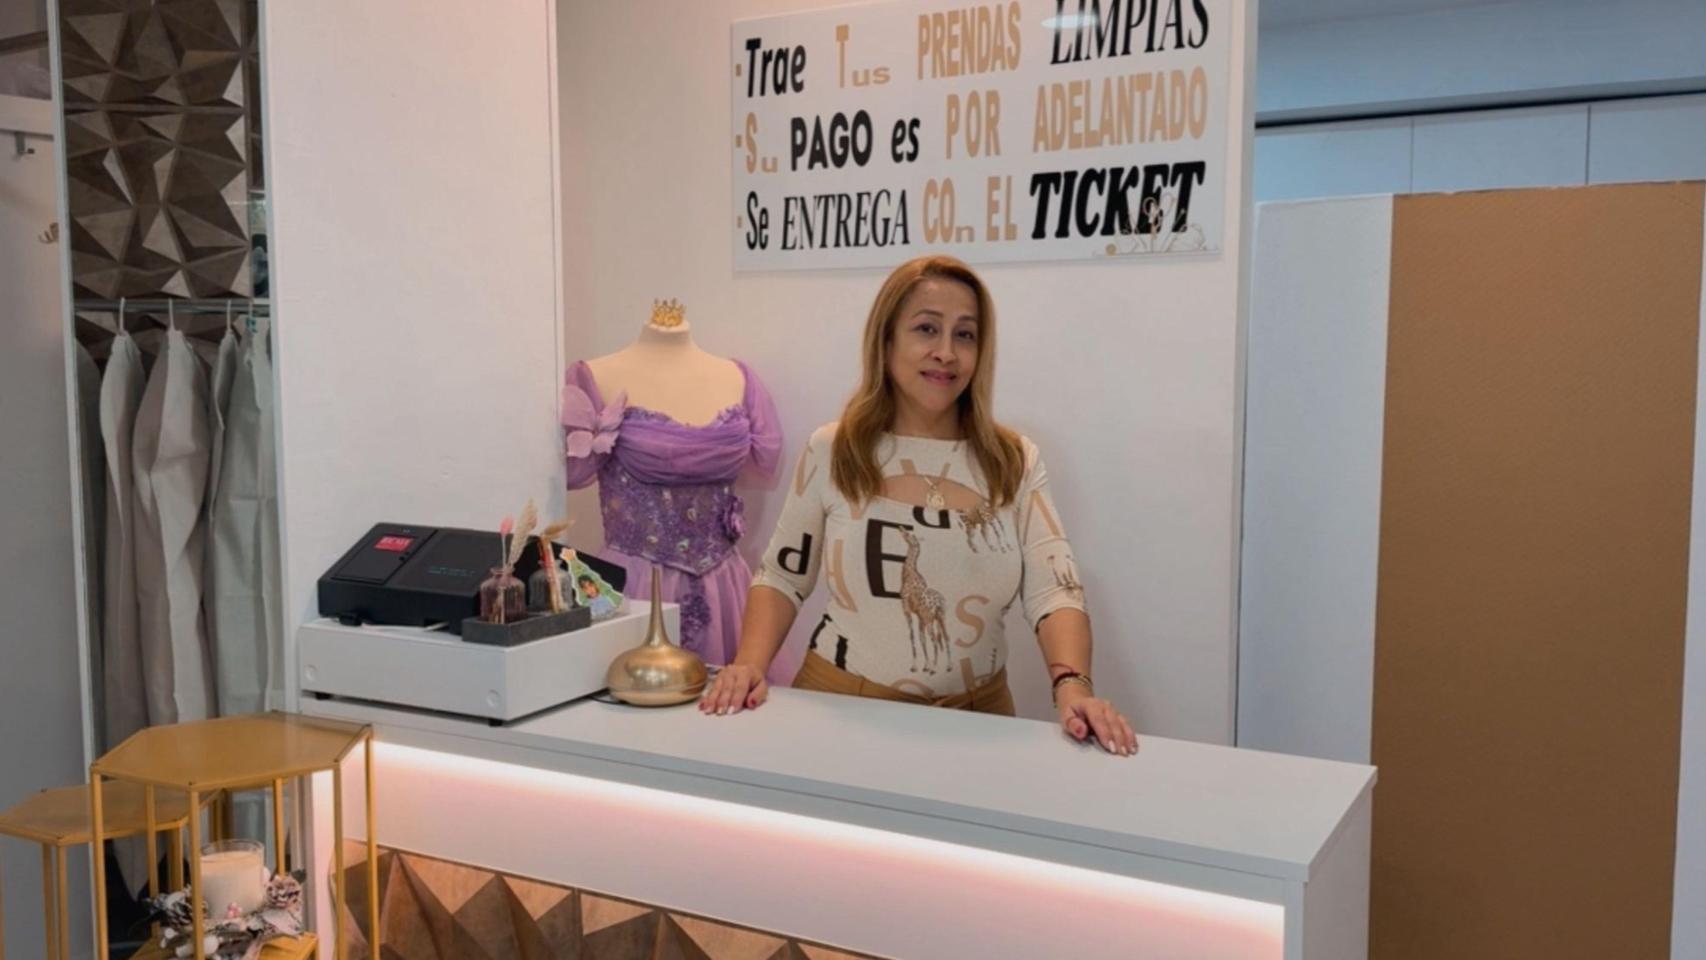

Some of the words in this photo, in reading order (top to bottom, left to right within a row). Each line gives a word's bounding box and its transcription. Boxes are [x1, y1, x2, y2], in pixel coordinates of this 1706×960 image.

[745, 37, 807, 98] Trae
[835, 24, 891, 88] Tus
[918, 1, 1022, 80] PRENDAS
[1050, 0, 1209, 64] LIMPIAS
[745, 111, 778, 174] Su
[790, 109, 873, 171] PAGO
[890, 117, 921, 163] es
[945, 90, 1001, 159] POR
[1033, 66, 1208, 152] ADELANTADO
[745, 190, 769, 250] Se
[780, 188, 910, 250] ENTREGA
[985, 175, 1018, 242] EL
[1029, 160, 1206, 239] TICKET
[865, 518, 914, 600] E
[954, 595, 990, 648] S
